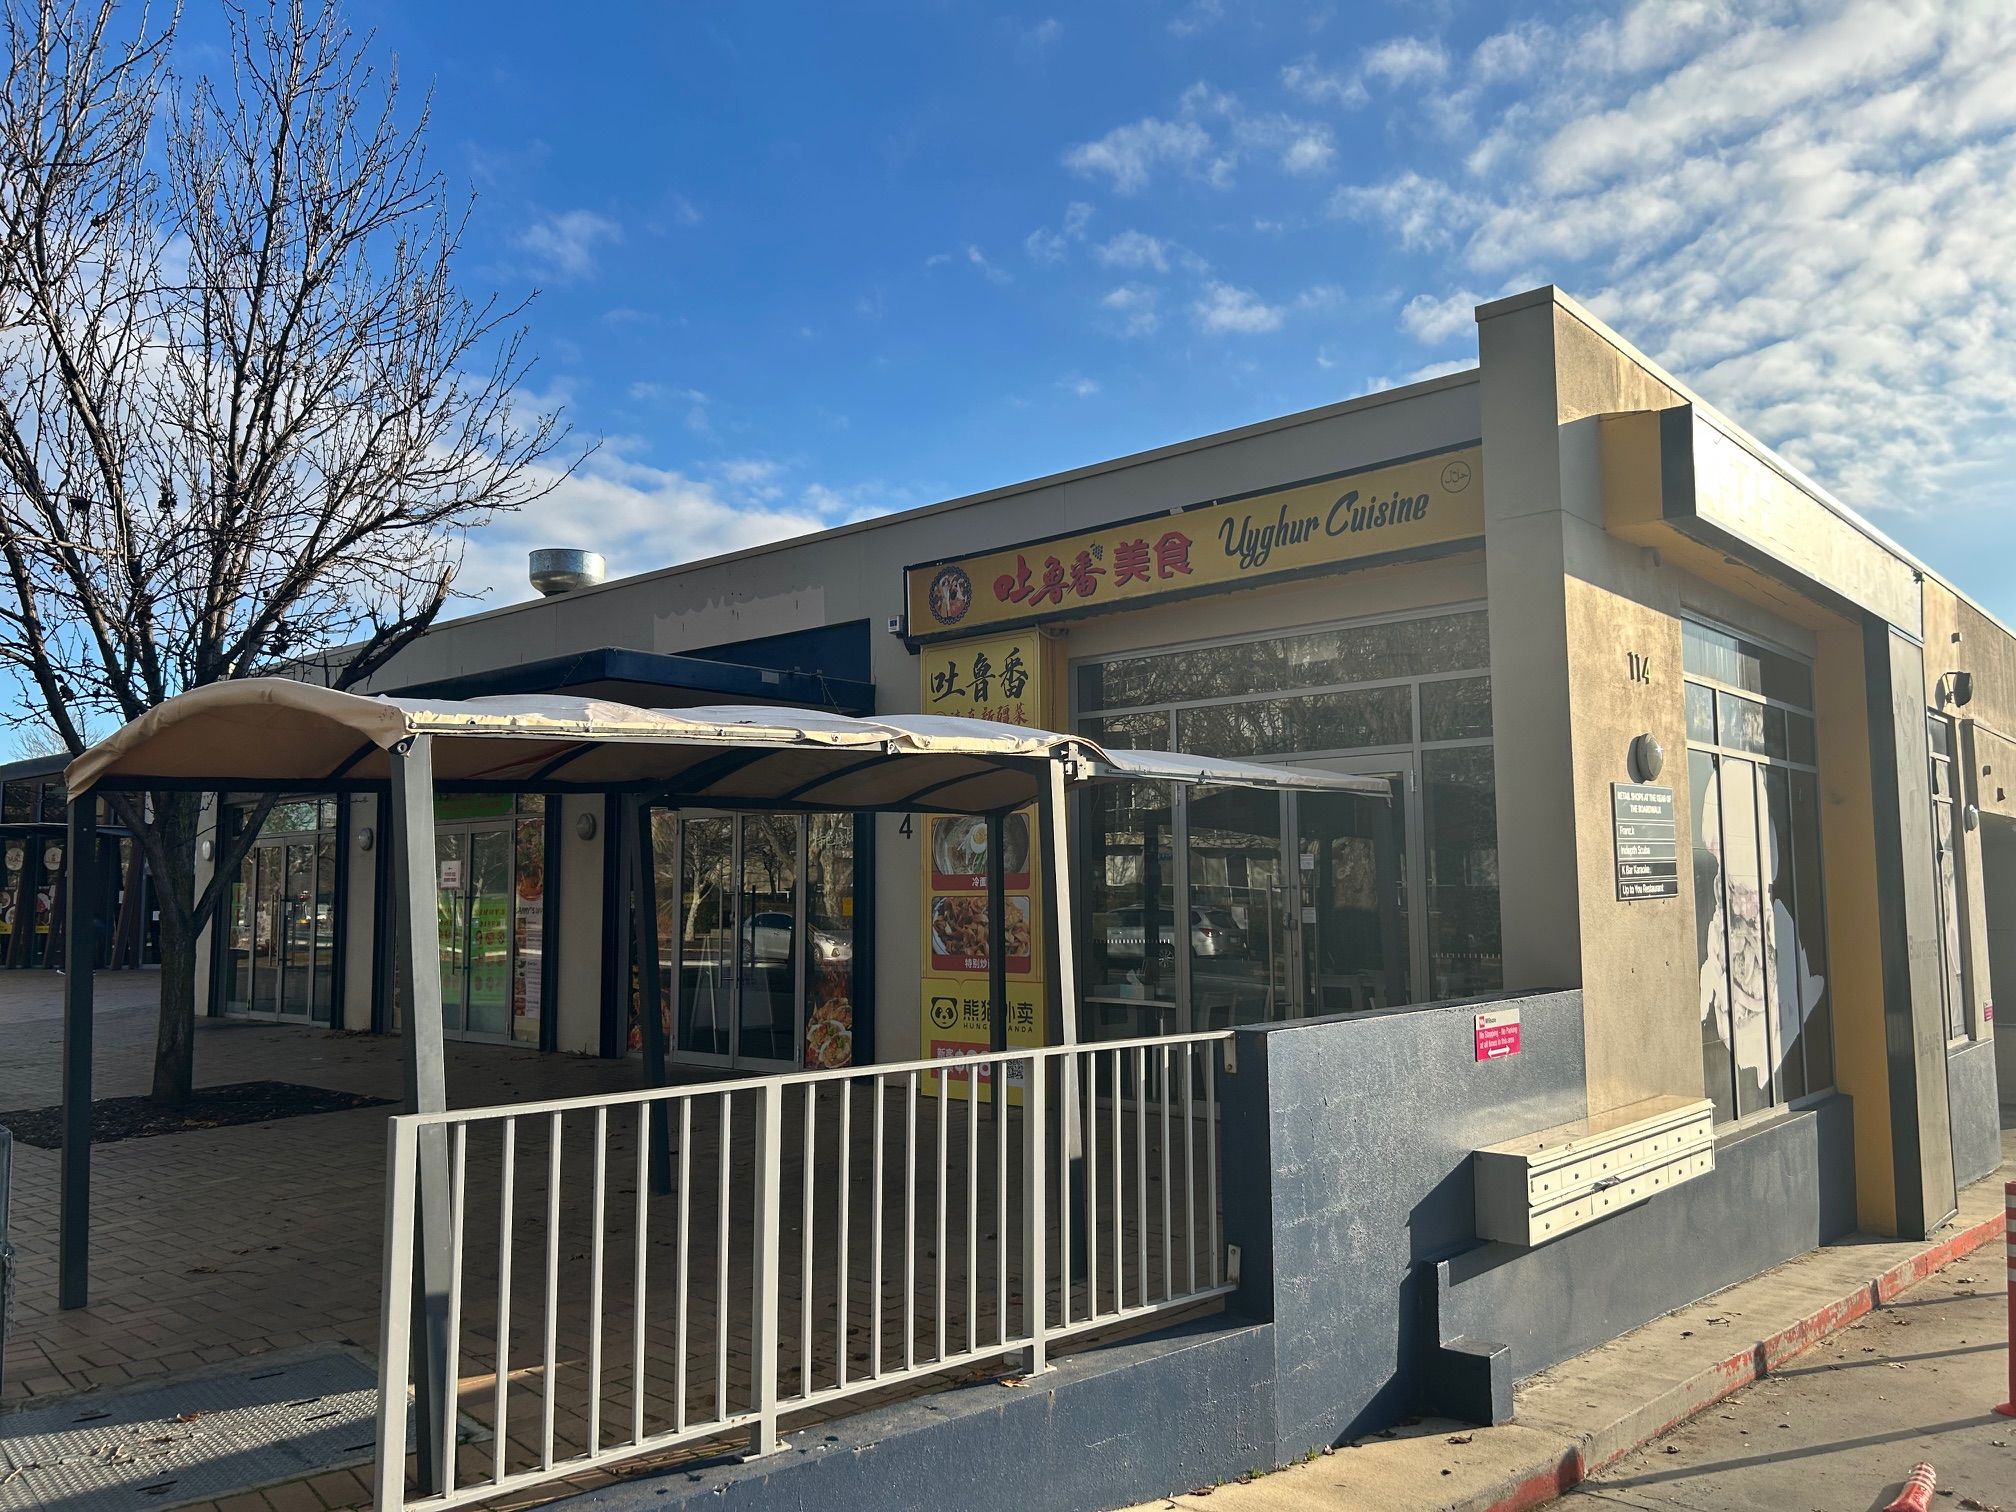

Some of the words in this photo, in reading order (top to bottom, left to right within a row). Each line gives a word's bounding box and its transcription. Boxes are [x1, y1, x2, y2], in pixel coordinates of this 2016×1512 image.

[1218, 504, 1320, 570] Uyghur
[1325, 490, 1430, 537] Cuisine
[1627, 651, 1651, 685] 114
[899, 813, 913, 839] 4
[1637, 845, 1651, 855] Scuba
[1622, 885, 1630, 896] Up
[1630, 884, 1635, 894] to
[1634, 884, 1643, 894] You
[1643, 883, 1664, 893] Restaurant
